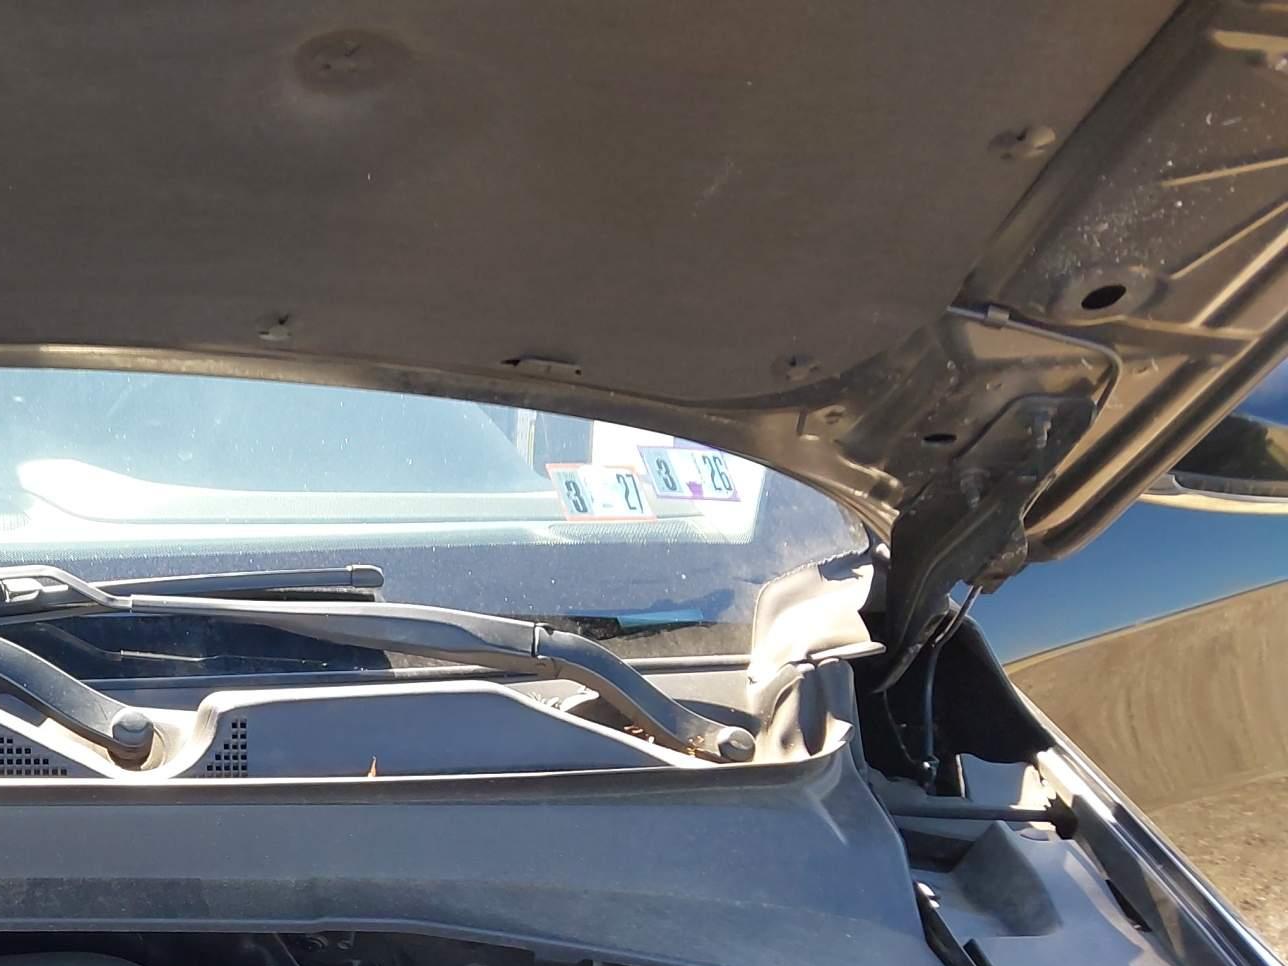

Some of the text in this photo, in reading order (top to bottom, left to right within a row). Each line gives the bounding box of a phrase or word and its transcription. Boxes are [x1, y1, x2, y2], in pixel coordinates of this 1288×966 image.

[655, 455, 733, 492] 3 26
[564, 473, 643, 514] 3 27
